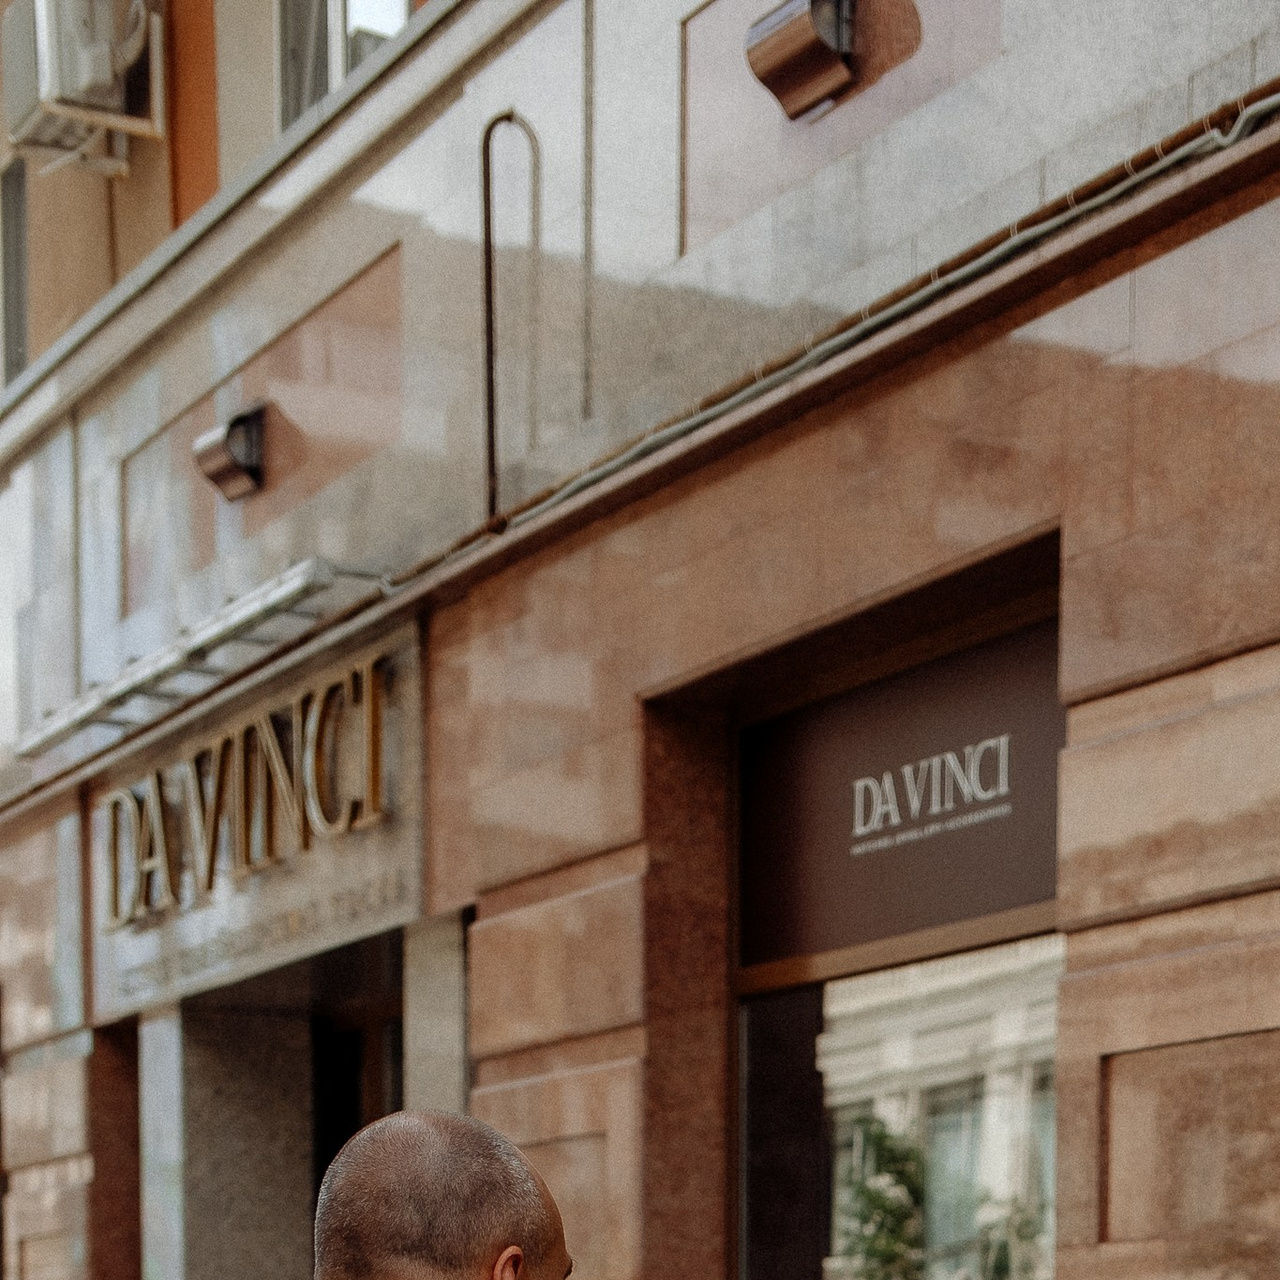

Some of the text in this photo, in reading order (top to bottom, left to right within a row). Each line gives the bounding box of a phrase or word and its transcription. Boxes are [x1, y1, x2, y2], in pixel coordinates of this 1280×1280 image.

[106, 767, 179, 933] DA
[186, 655, 390, 898] VINCI
[852, 771, 902, 838] DA
[901, 734, 1010, 819] VINCI
